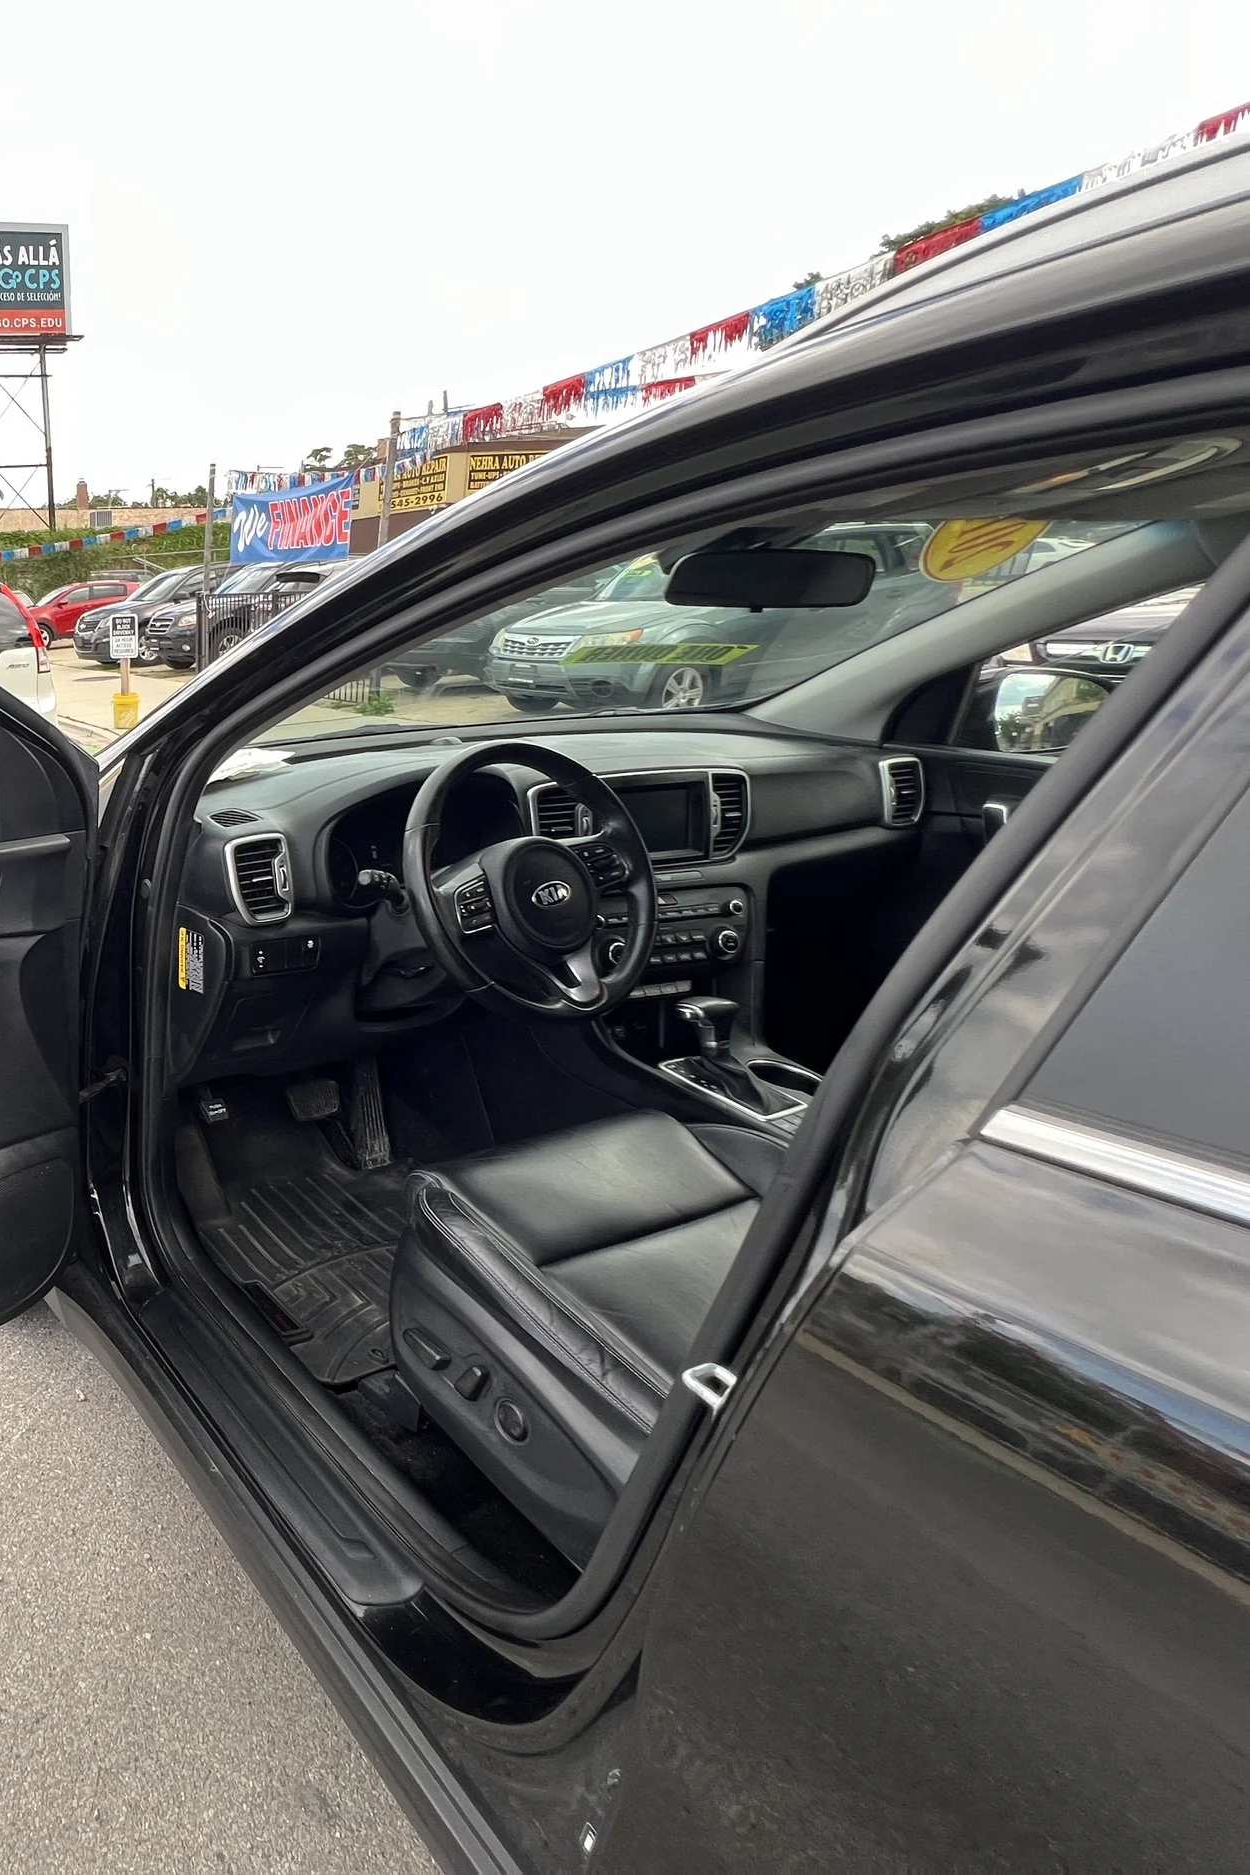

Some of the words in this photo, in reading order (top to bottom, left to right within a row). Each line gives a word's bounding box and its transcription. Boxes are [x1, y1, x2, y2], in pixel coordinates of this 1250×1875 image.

[18, 239, 59, 265] ALLÁ
[17, 292, 25, 301] DE
[470, 455, 500, 471] NEHRA
[502, 454, 526, 469] AUTO
[234, 504, 268, 552] We
[268, 487, 351, 550] FINANCE
[538, 885, 568, 905] KIA
